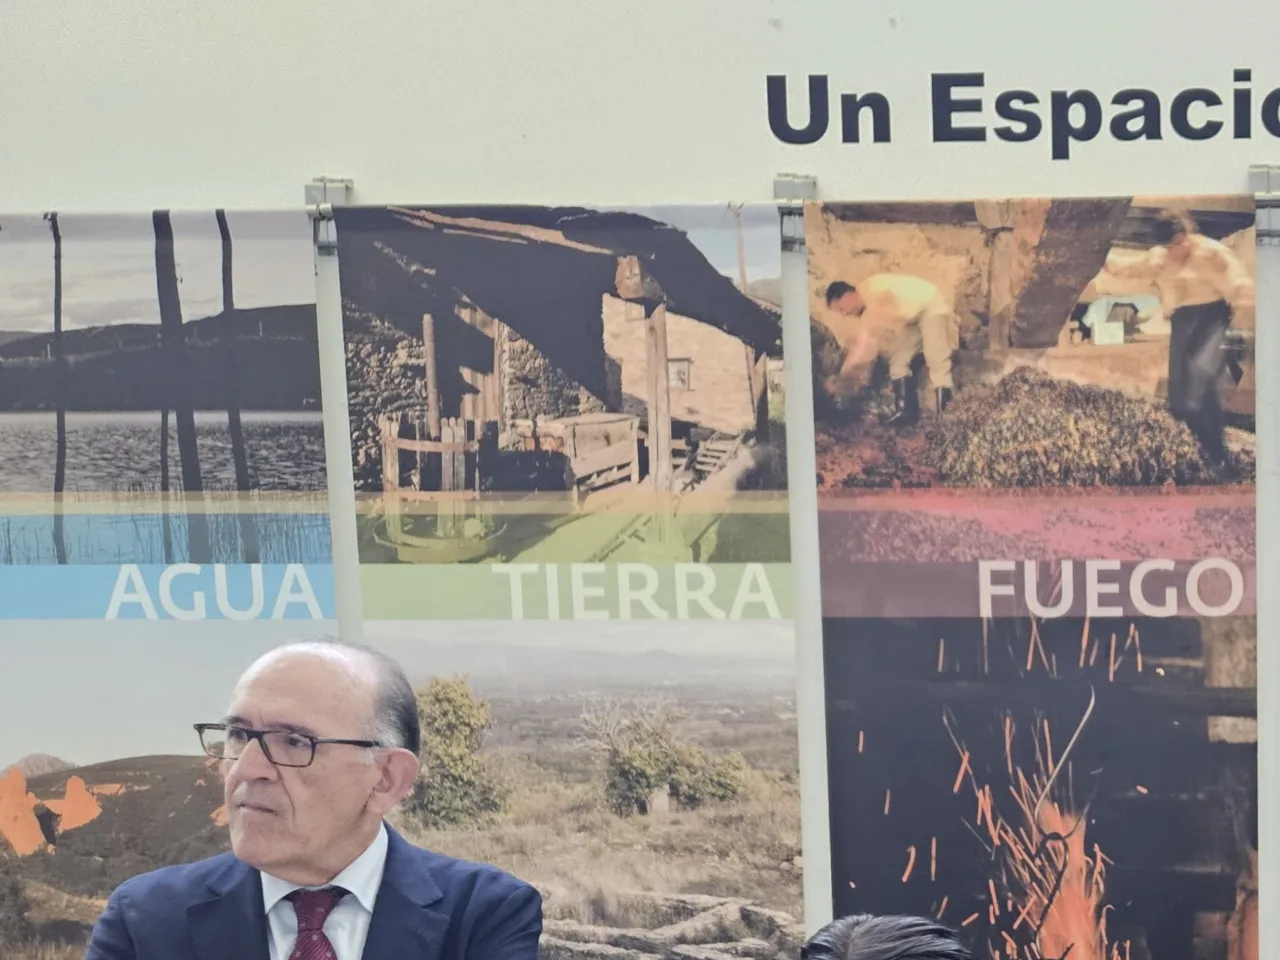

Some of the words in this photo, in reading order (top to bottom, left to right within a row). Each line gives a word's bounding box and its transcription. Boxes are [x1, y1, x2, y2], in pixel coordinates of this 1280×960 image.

[767, 74, 891, 144] Un
[105, 563, 324, 620] AGUA
[491, 562, 783, 620] TIERRA
[978, 557, 1244, 618] FUEGO
